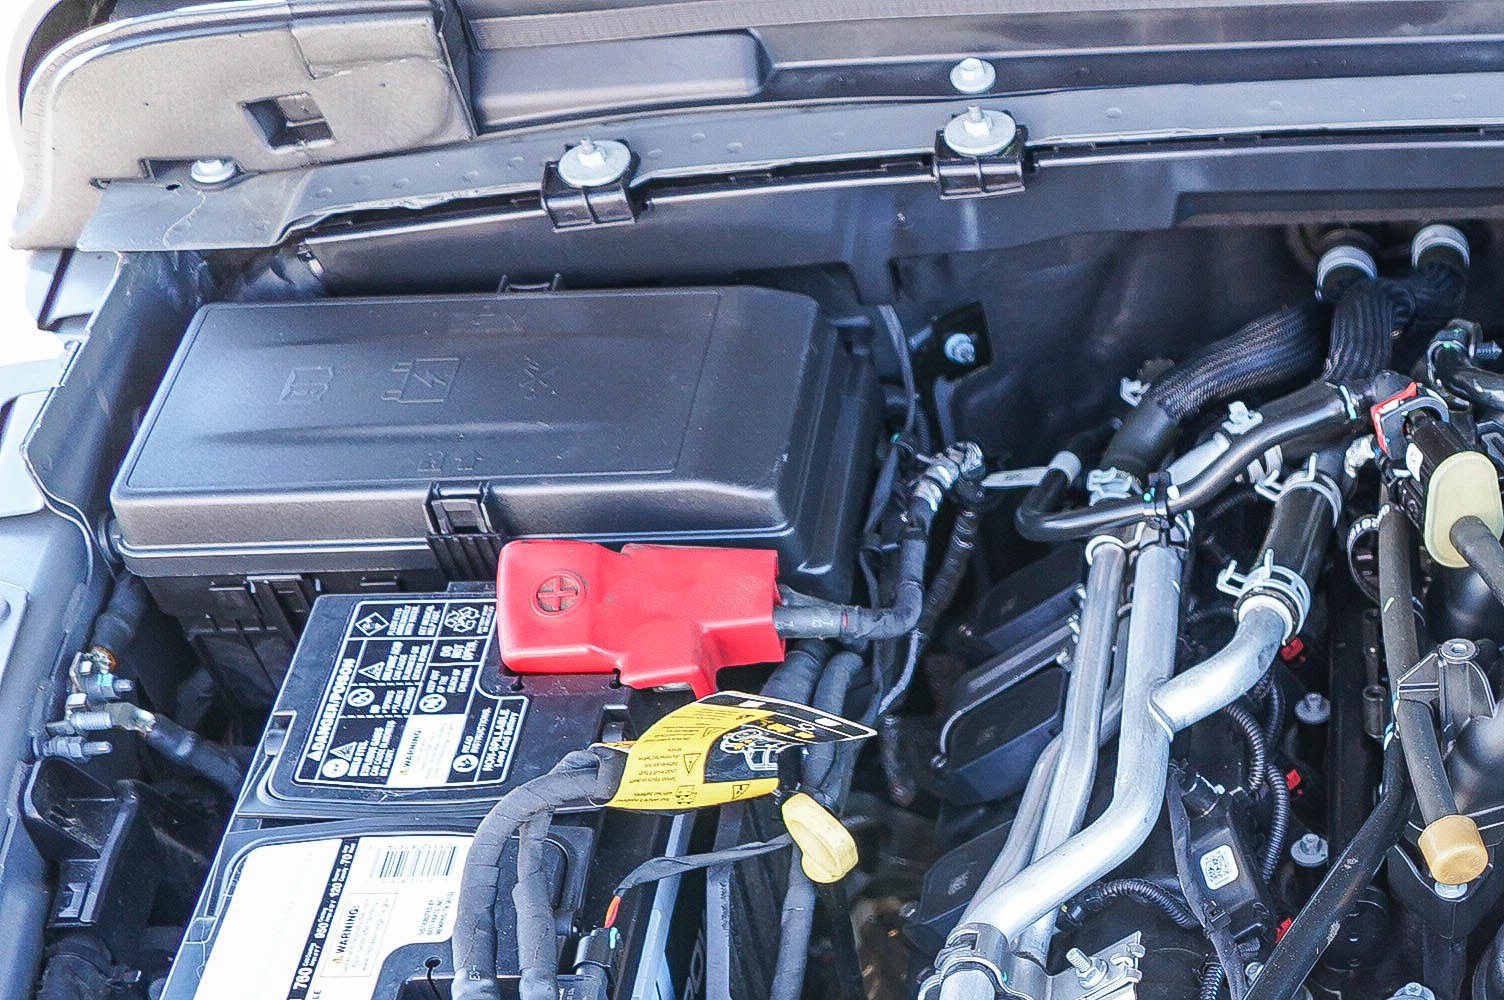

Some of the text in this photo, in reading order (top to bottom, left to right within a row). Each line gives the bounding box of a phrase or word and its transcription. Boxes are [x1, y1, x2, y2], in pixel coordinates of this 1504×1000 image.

[440, 646, 453, 657] DO
[451, 644, 464, 658] NOT
[311, 658, 355, 750] DANGER/POISON
[461, 736, 473, 753] READ
[482, 709, 510, 771] NON-SPILLABLE
[340, 854, 353, 864] 70
[329, 883, 343, 897] 120
